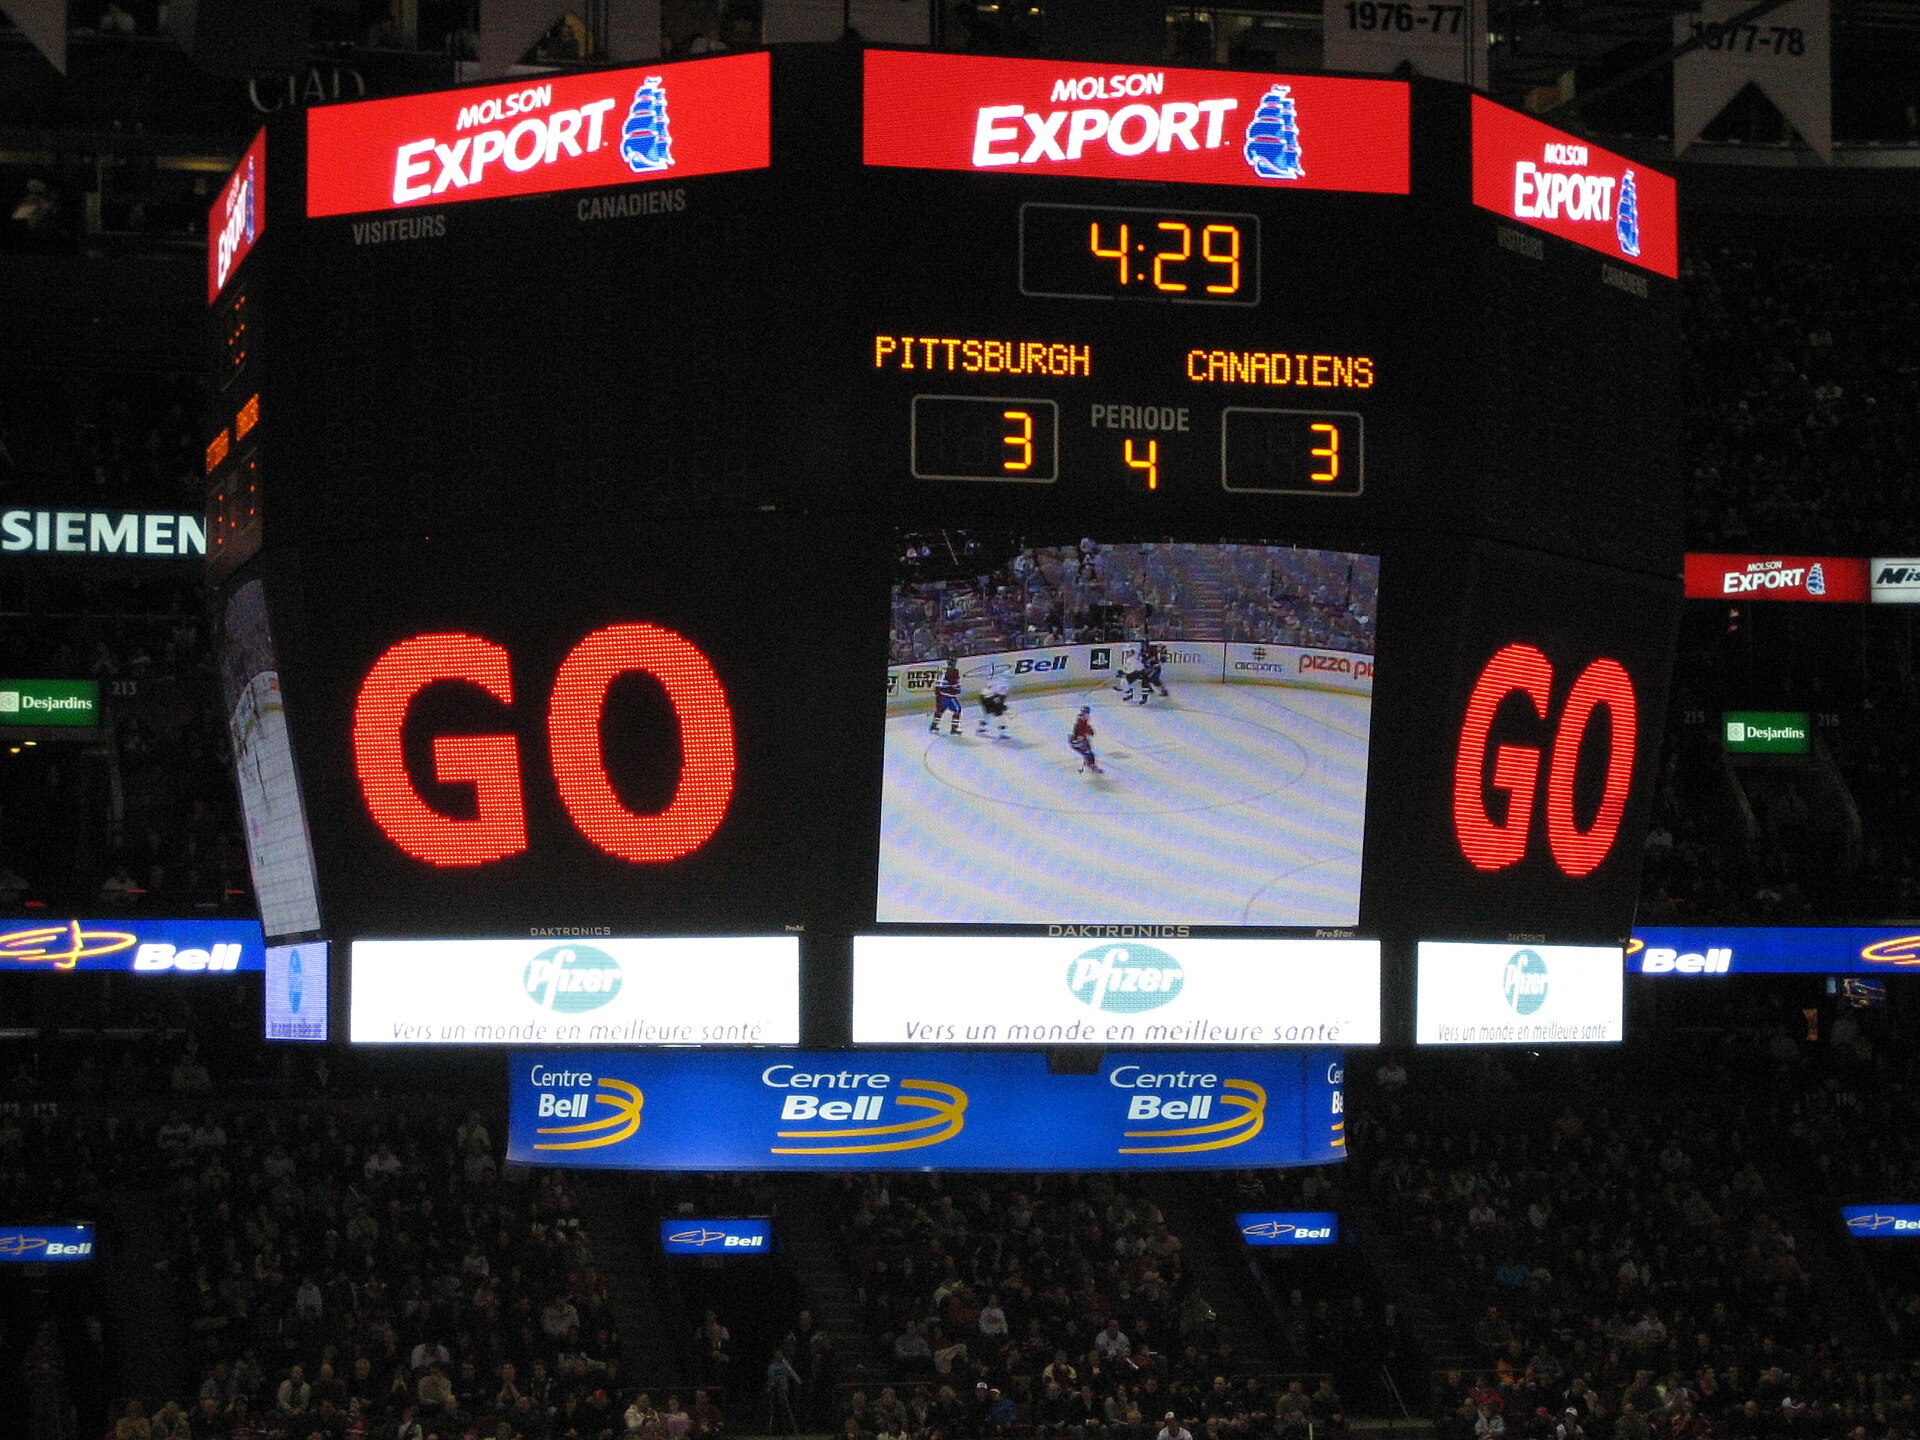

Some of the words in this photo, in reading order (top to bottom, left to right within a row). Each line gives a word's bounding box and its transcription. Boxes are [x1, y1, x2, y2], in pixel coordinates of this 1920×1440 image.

[1344, 2, 1462, 34] 1976-77
[1051, 72, 1164, 102] MOLSON
[456, 84, 552, 131] MOLSON
[972, 98, 1238, 167] EXPORT
[393, 98, 615, 204] EXPORT
[1544, 143, 1589, 167] MOLSON
[577, 188, 686, 222] CANADIENS
[352, 213, 446, 245] VISITEURS
[1090, 222, 1240, 294] 4:29
[875, 336, 1090, 377] PITTSBURGH
[1187, 350, 1374, 388] CANADIENS
[1090, 403, 1190, 432] PERIODE
[1003, 411, 1032, 470] 3
[1311, 424, 1339, 481] 3
[1125, 439, 1157, 490] 4
[1747, 561, 1782, 572] MOLSON
[1723, 568, 1805, 593] EXPORT
[1014, 655, 1070, 675] Bell
[1299, 654, 1350, 673] pizza
[111, 681, 138, 696] 213
[22, 696, 93, 712] Desjardins
[353, 622, 737, 868] GO
[1747, 726, 1806, 741] Desjardins
[1453, 642, 1637, 878] GO
[530, 926, 611, 937] DAKTRONICS
[1049, 925, 1190, 938] DAKTRONICS
[133, 943, 243, 971] Bell
[1642, 948, 1733, 973] Bell
[525, 949, 623, 1010] Pfizer
[1070, 949, 1184, 1010] Pfizer
[1504, 953, 1551, 1012] Pfizer
[393, 1022, 432, 1040] Vers
[441, 1024, 466, 1040] un
[474, 1019, 547, 1040] monde
[556, 1024, 581, 1040] en
[589, 1018, 693, 1041] meilleure
[906, 1021, 956, 1040] Vers
[966, 1024, 997, 1040] un
[1007, 1019, 1096, 1040] monde
[1105, 1024, 1135, 1040] en
[1145, 1019, 1264, 1041] meilleure
[1438, 1023, 1460, 1042] Vers
[1462, 1026, 1476, 1041] un
[1479, 1021, 1515, 1041] monde
[1517, 1025, 1530, 1040] en
[1532, 1020, 1578, 1040] meilleure
[531, 1064, 593, 1088] Centre
[762, 1065, 891, 1089] Centre
[1109, 1065, 1218, 1088] Centre
[538, 1094, 589, 1118] Bell
[780, 1096, 883, 1121] Bell
[1127, 1095, 1213, 1120] Bell
[724, 1236, 763, 1246] Bell
[1294, 1228, 1331, 1239] Bell
[46, 1243, 92, 1254] Bell
